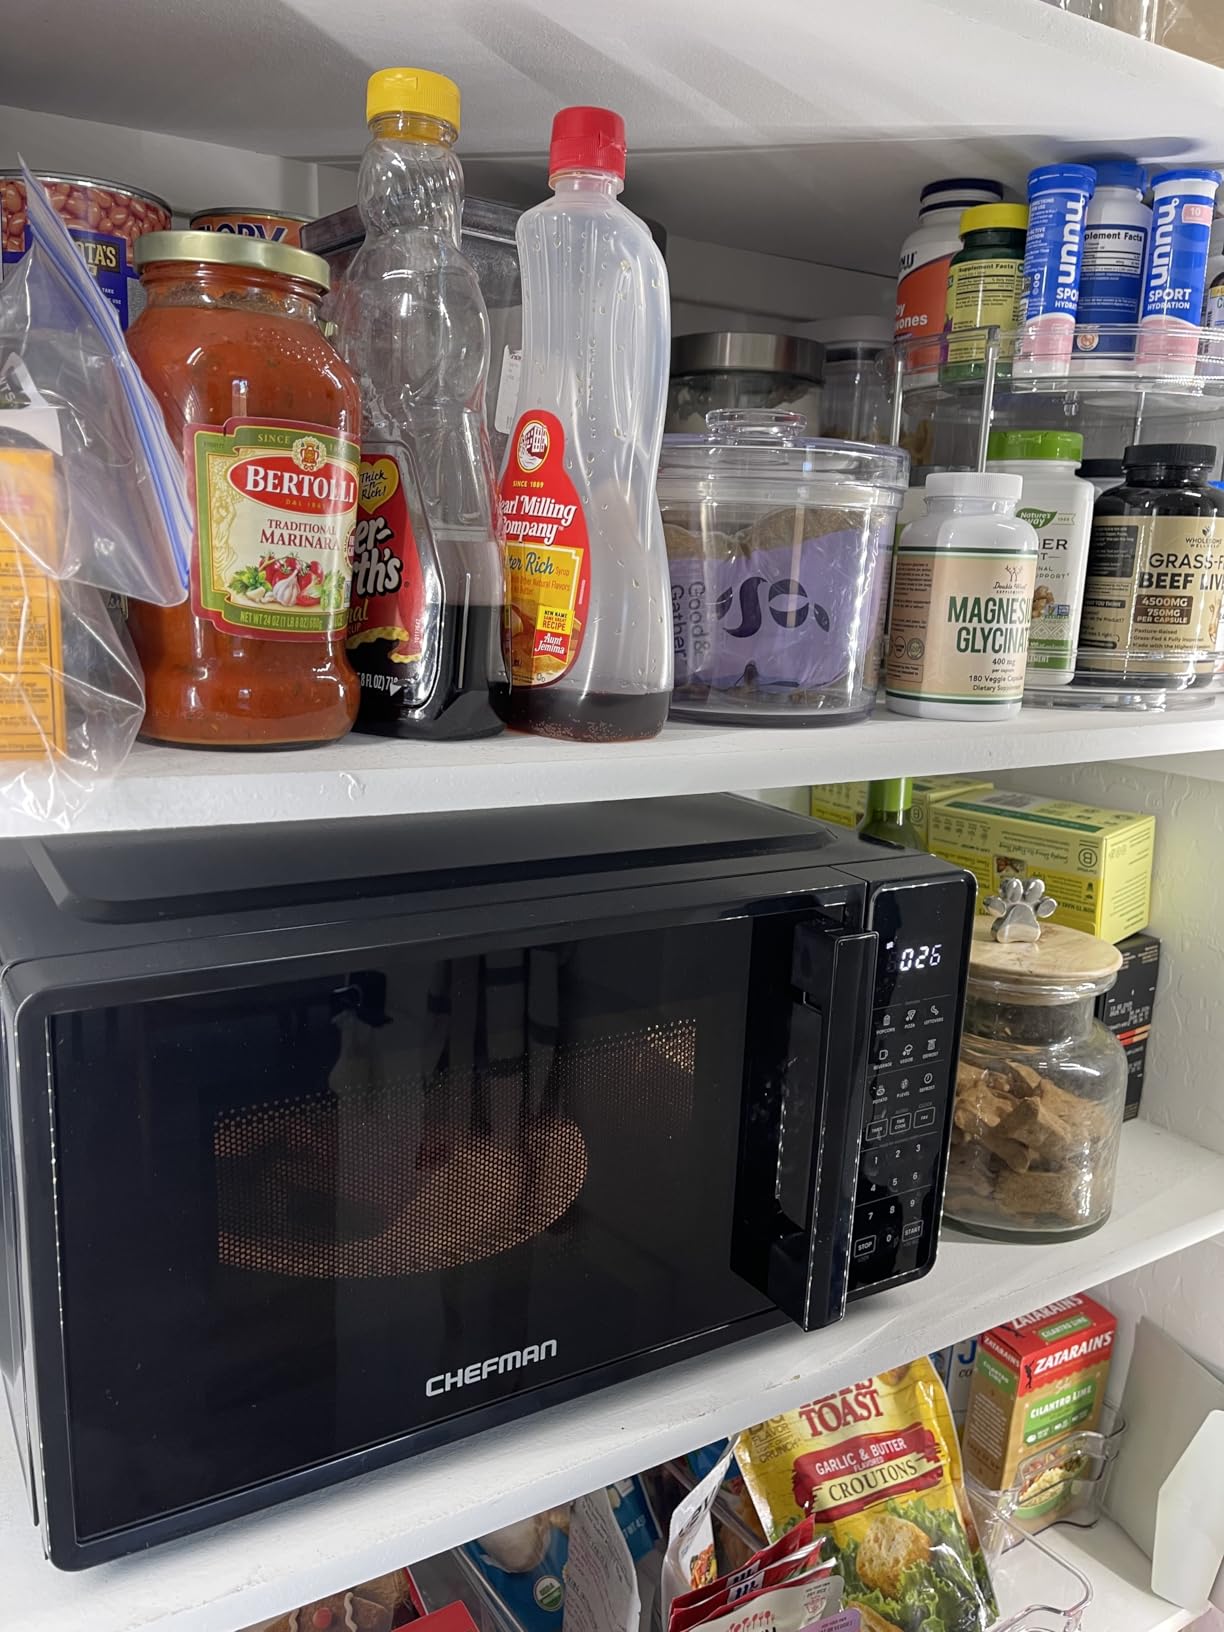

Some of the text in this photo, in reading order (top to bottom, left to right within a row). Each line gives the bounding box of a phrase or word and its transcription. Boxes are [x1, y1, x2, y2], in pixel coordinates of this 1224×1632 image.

[1190, 207, 1201, 217] 10
[1148, 288, 1192, 302] SPORT
[1147, 301, 1190, 311] HYDRATION
[257, 433, 290, 445] SINCE
[245, 465, 356, 504] BERTOLLI
[512, 480, 528, 488] SINCE
[499, 494, 577, 527] earl Milling
[267, 518, 337, 537] TRADITIONAL
[502, 516, 559, 547] ompany
[260, 529, 340, 552] MARINARA
[525, 551, 555, 576] Rich
[1138, 571, 1195, 590] BEEF
[1141, 596, 1189, 607] 4500MG
[1147, 608, 1181, 617] 750MG
[1136, 615, 1188, 624] PER CAPSULE
[542, 620, 567, 632] RECIPE
[543, 633, 564, 646] Aunt
[534, 640, 566, 655] Jemima
[984, 675, 1006, 684] Veggie
[915, 1144, 921, 1152] 3
[895, 1150, 901, 1158] 2
[874, 1157, 879, 1165] 1
[912, 1172, 918, 1180] 6
[892, 1178, 898, 1186] 5
[870, 1184, 876, 1192] 4
[909, 1199, 916, 1208] 9
[889, 1206, 895, 1214] 8
[868, 1212, 874, 1220] 7
[904, 1225, 921, 1236] START
[886, 1234, 892, 1243] 0
[858, 1241, 873, 1251] STOP
[425, 1338, 558, 1398] CHEFMAN
[1030, 1385, 1093, 1419] CILANTRO LIME
[799, 1389, 884, 1438] TOAST
[752, 1422, 790, 1446] FLAVOR
[815, 1437, 908, 1476] GARLIC & BUTTER
[853, 1456, 885, 1473] FLAVORED
[828, 1459, 918, 1502] CROUTONS
